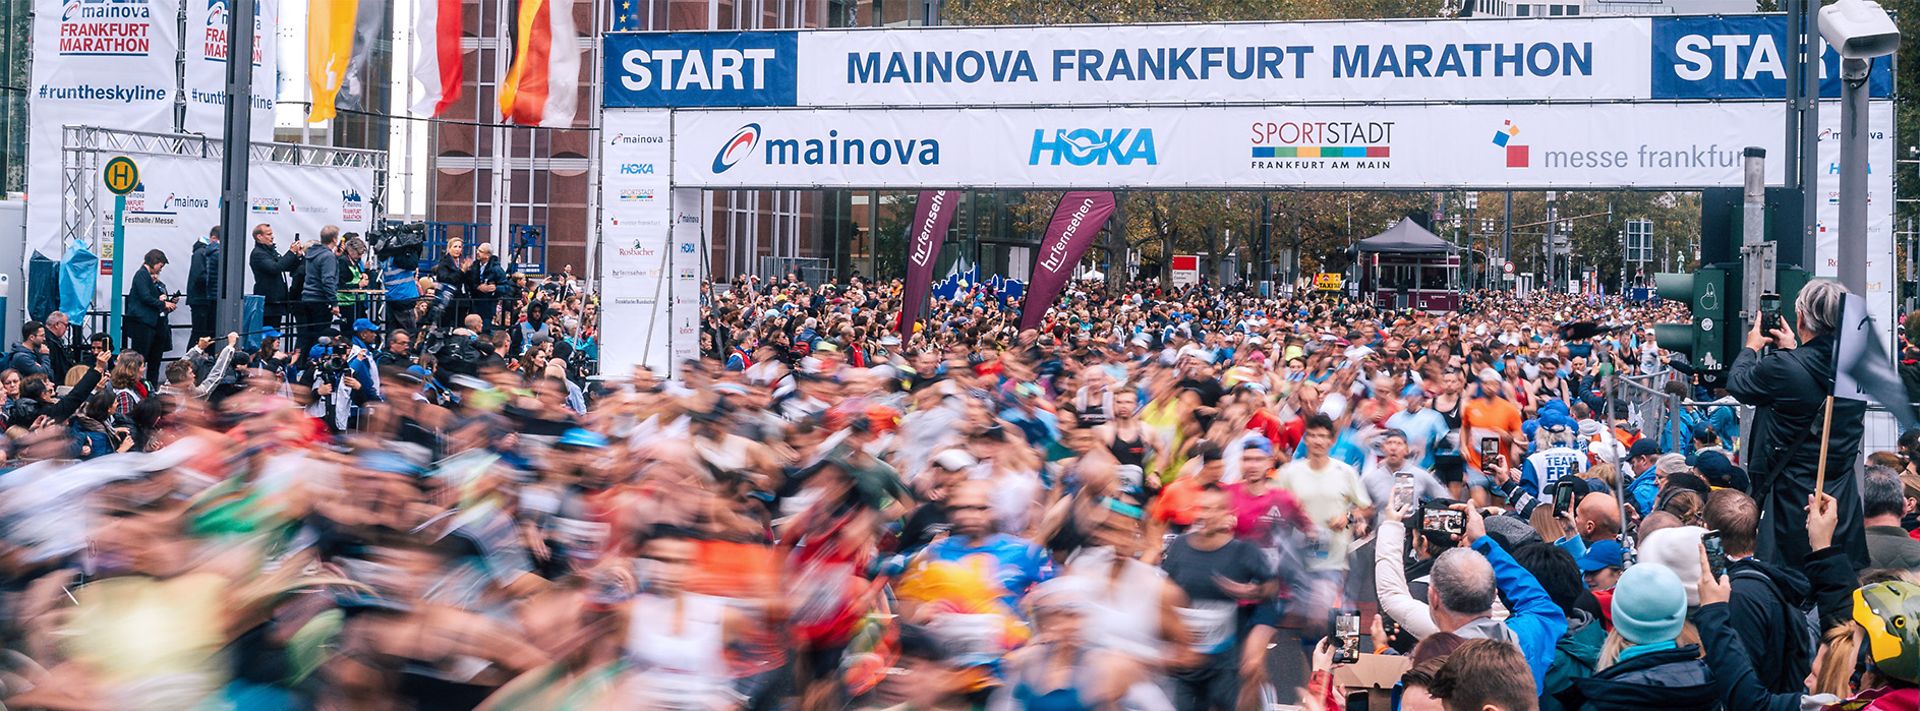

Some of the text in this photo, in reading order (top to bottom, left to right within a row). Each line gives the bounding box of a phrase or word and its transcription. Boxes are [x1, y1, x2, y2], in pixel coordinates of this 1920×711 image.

[82, 3, 149, 18] mainova
[61, 23, 149, 37] FRANKFURT
[60, 38, 149, 52] MARATHON
[621, 49, 775, 91] START
[848, 42, 1593, 84] MAINOVA FRANKFURT MARATHON
[39, 84, 166, 103] #runtheskyline
[623, 134, 664, 144] mainova
[1251, 122, 1395, 145] SPORTSTADT
[765, 129, 940, 166] mainova
[1028, 128, 1158, 167] HOKA
[1544, 144, 1746, 168] messe frankfur
[620, 164, 655, 174] HOKA
[1251, 161, 1390, 169] FRANKFURT AM MAIN
[113, 165, 128, 187] H
[174, 196, 209, 208] mainova
